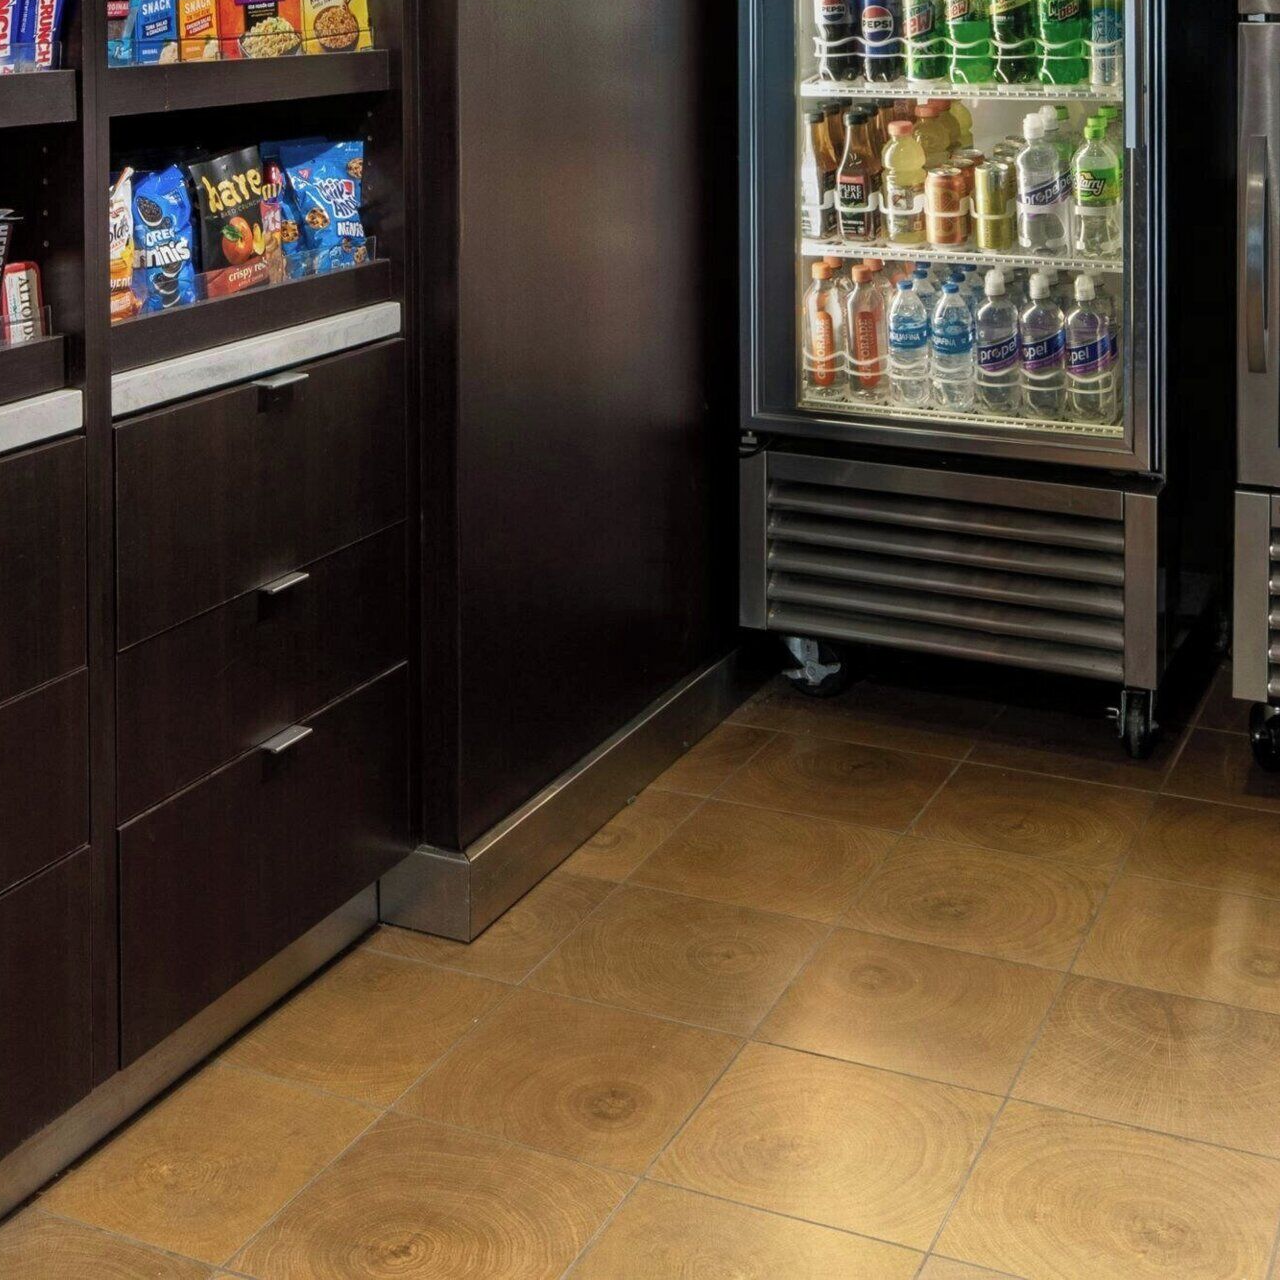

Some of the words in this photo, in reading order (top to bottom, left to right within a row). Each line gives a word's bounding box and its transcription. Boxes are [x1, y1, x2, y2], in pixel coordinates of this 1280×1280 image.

[821, 5, 845, 13] PEPSI
[862, 19, 892, 29] PEPSI
[202, 167, 262, 214] bare
[980, 336, 1017, 363] propel
[1023, 341, 1048, 358] opel
